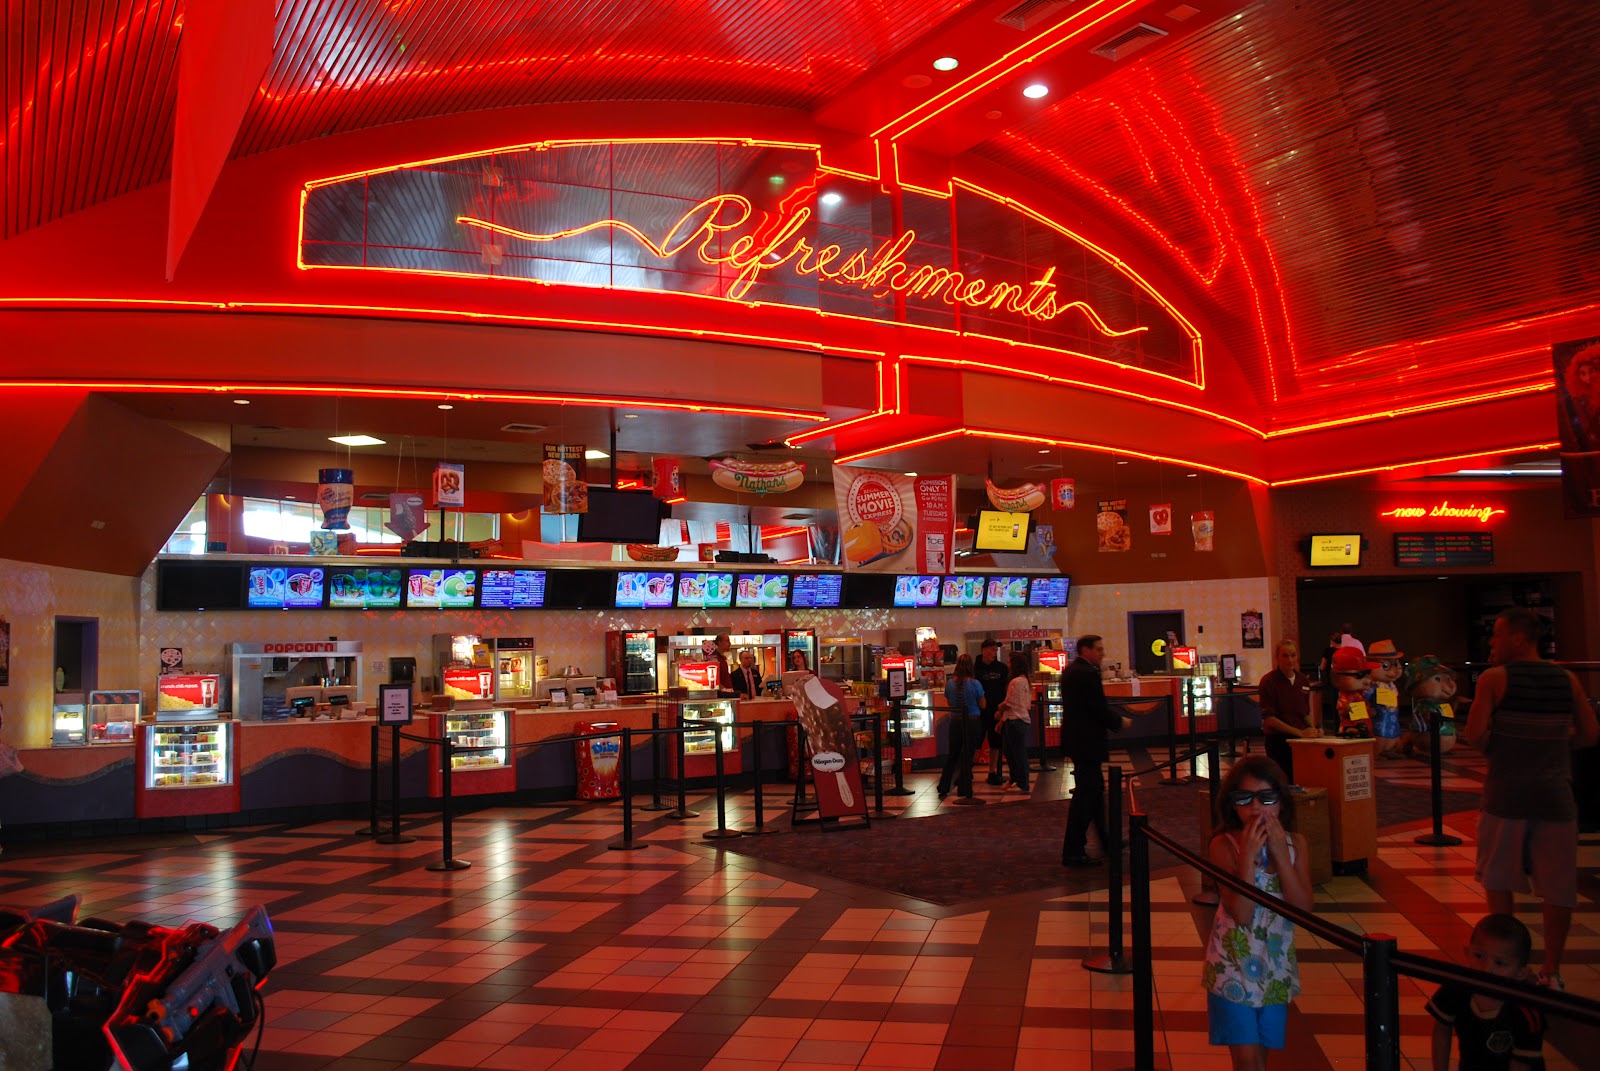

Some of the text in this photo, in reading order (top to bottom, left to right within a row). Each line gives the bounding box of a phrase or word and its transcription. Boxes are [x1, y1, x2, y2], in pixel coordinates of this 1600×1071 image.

[645, 192, 1090, 325] Refreshments
[857, 490, 890, 502] SUMMER
[858, 499, 894, 514] MOVIE
[1388, 501, 1497, 522] now showing
[864, 508, 892, 520] EXPRESS
[592, 742, 618, 754] Dibs
